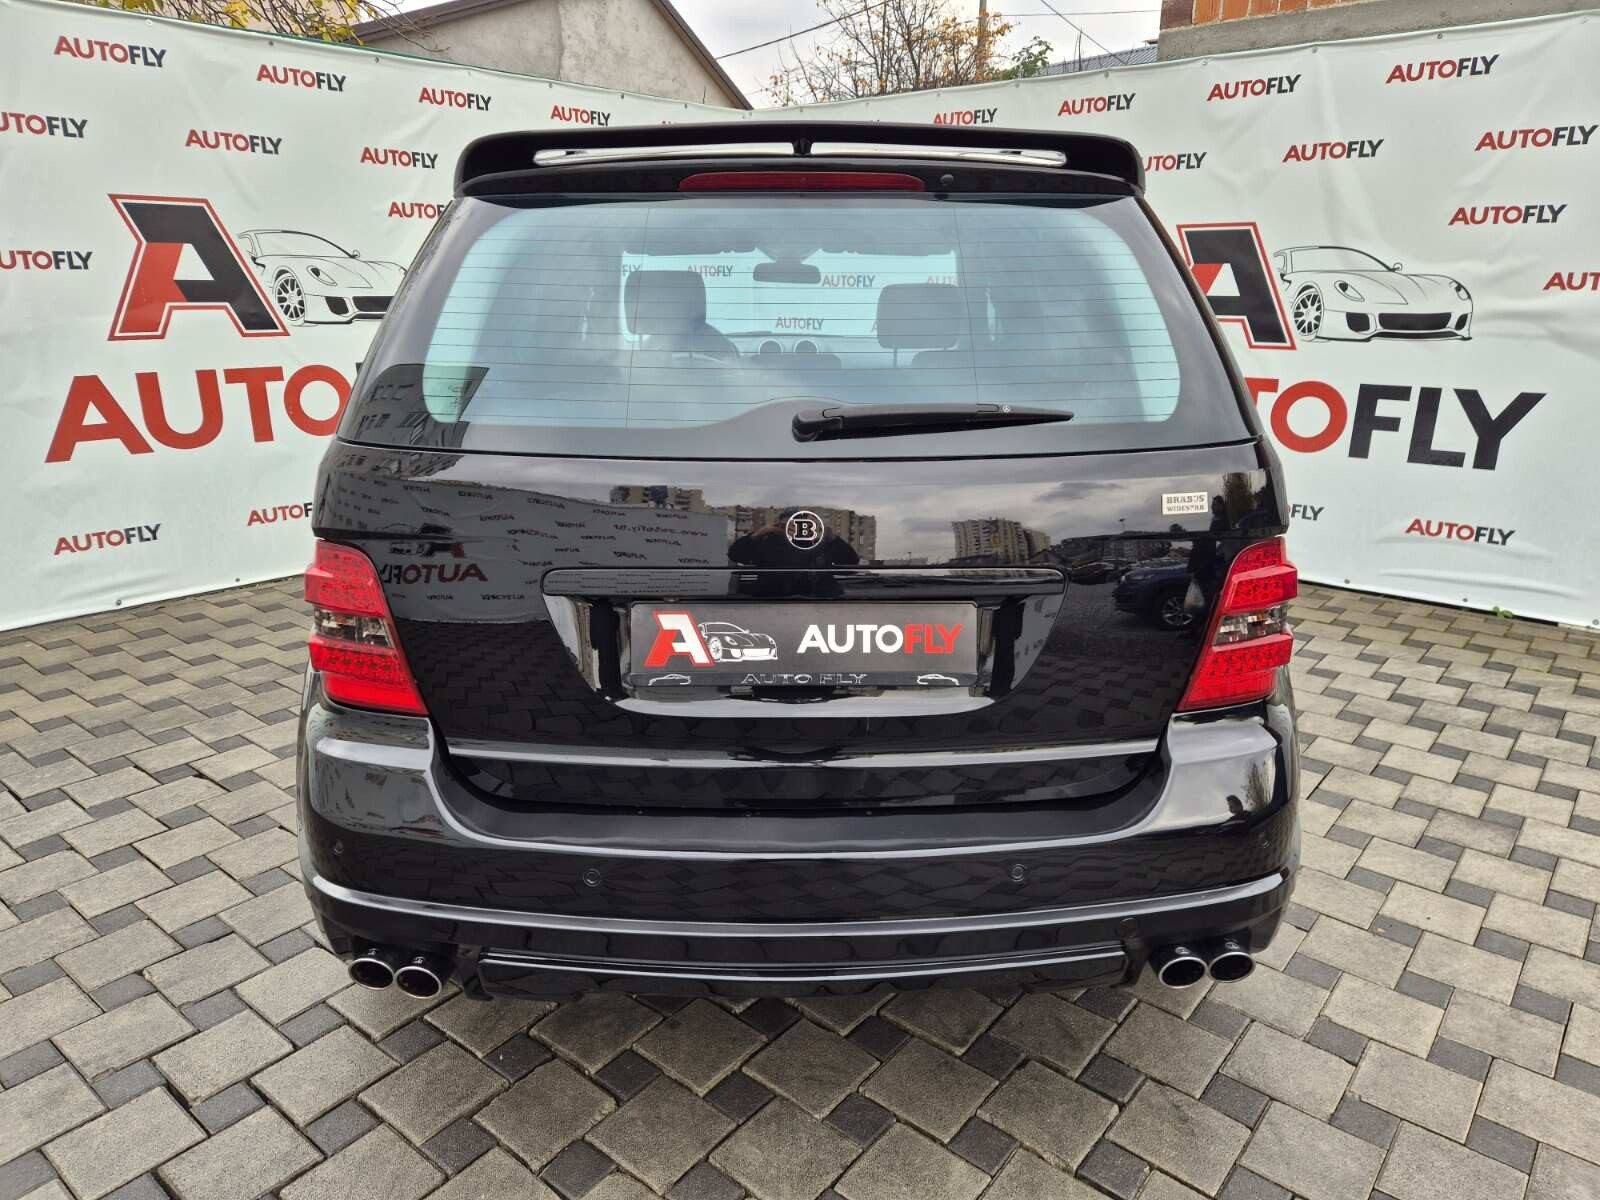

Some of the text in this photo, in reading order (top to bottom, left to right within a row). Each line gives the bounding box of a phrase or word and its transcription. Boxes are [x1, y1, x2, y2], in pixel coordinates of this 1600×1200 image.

[54, 36, 166, 67] AUTOFLY
[257, 65, 346, 92] AUTOFLY
[1386, 54, 1499, 84] AUTOFLY
[419, 88, 491, 111] AUTOFLY
[1207, 74, 1301, 102] AUTOFLY
[551, 105, 610, 126] AUTOFLY
[1058, 93, 1135, 116] AUTOFLY
[934, 108, 998, 126] AUTOFLY
[186, 129, 282, 155] AUTOFLY
[1475, 125, 1599, 151] AUTOFLY
[361, 147, 438, 168] AUTOFLY
[1283, 139, 1384, 162] AUTOFLY
[1448, 204, 1567, 225] AUTOFLY
[822, 274, 876, 288] AUTOFLY
[775, 317, 824, 330] AUTOFLY
[45, 362, 364, 464] AUTO
[54, 524, 160, 556] AUTOFLY
[1406, 518, 1515, 545] AUTOFLY
[796, 624, 963, 654] AUTOFLY
[740, 674, 867, 685] AUTO FLY
